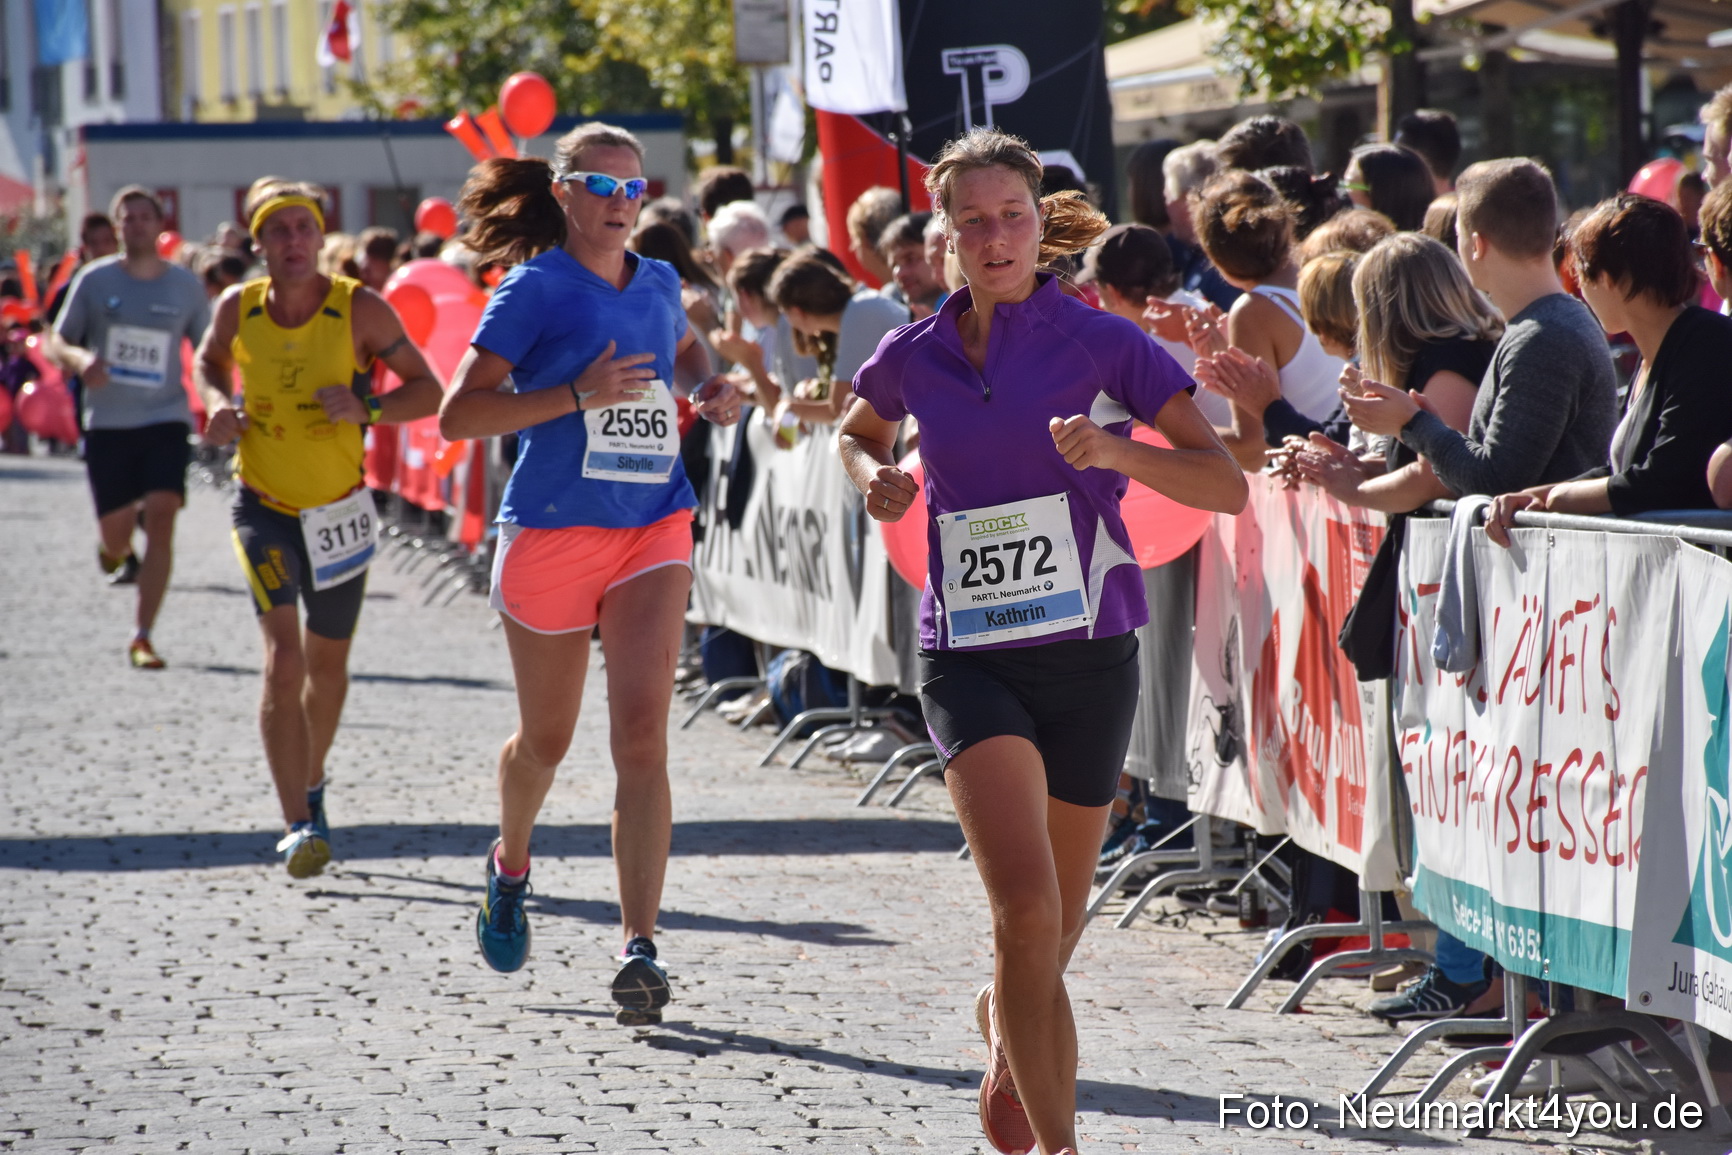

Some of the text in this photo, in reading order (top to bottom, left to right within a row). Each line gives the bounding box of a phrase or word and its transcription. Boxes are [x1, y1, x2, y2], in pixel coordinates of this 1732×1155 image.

[599, 408, 667, 439] 2556
[608, 441, 628, 449] PARTL
[617, 456, 654, 472] Sibylle
[317, 513, 370, 552] 3119
[969, 513, 1028, 536] BOCK
[960, 535, 1057, 589] 2572
[971, 584, 1041, 603] PARTL Neumarkt
[985, 604, 1046, 627] Kathrin
[1668, 961, 1699, 997] Jura
